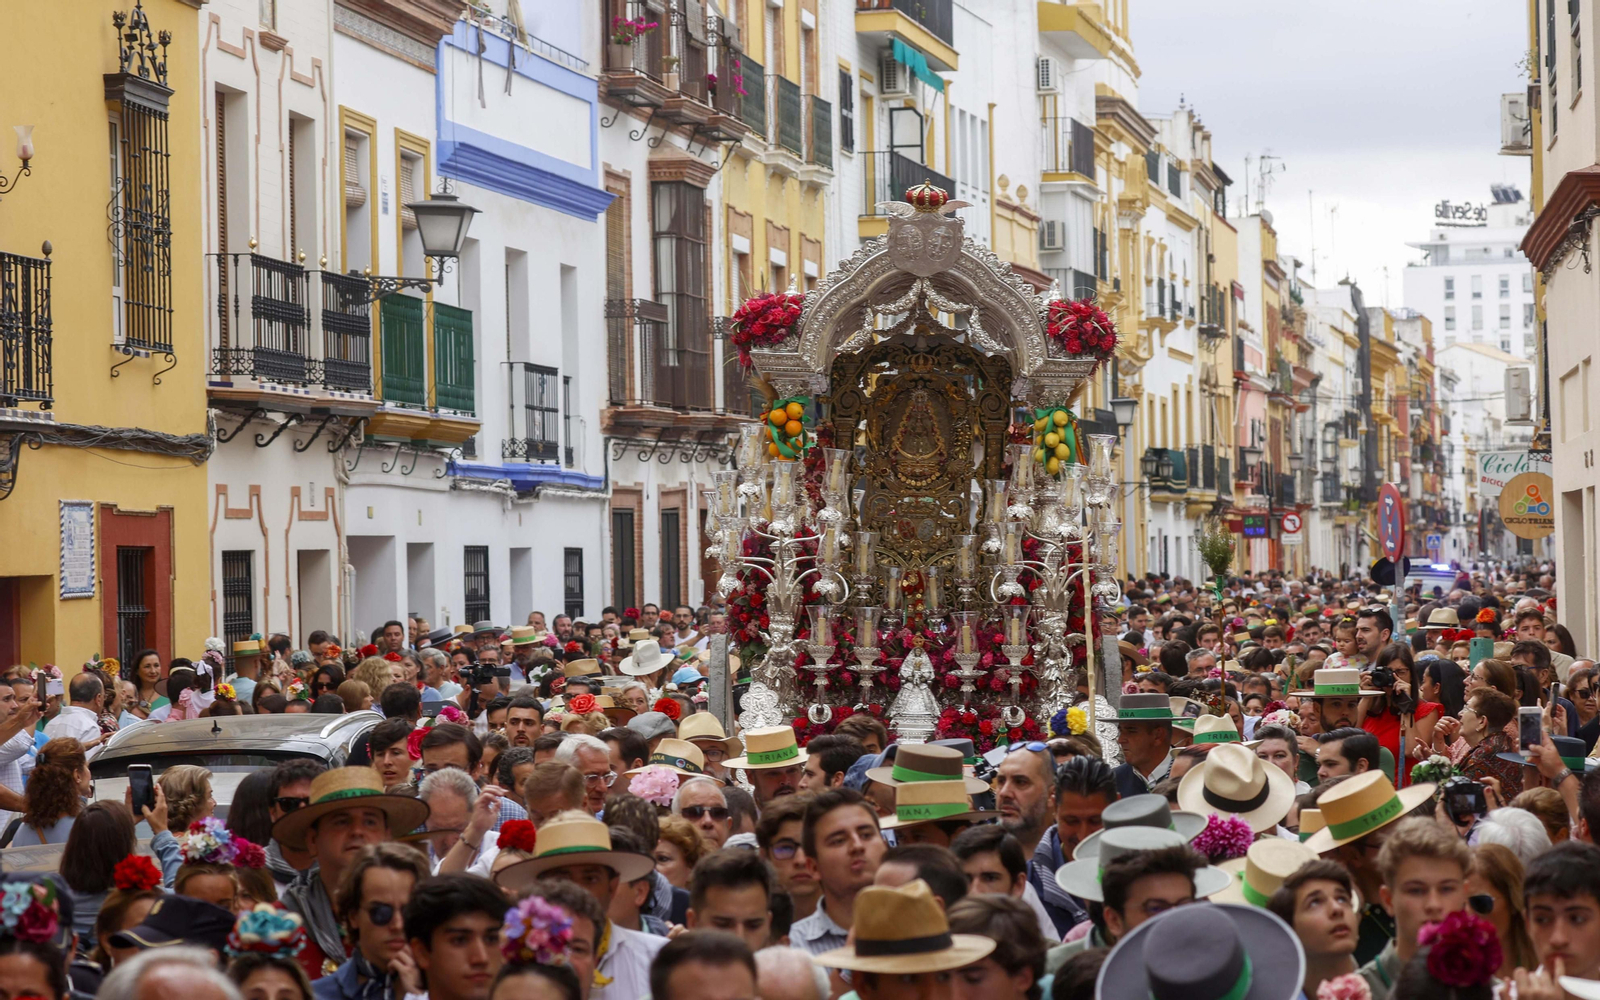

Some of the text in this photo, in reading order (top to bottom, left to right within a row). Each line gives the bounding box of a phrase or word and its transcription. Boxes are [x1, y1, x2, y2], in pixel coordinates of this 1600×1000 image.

[1480, 453, 1530, 474] Ciclo
[1481, 476, 1506, 488] BICICL
[759, 748, 794, 762] TRIANA
[1363, 800, 1401, 826] TRIAN
